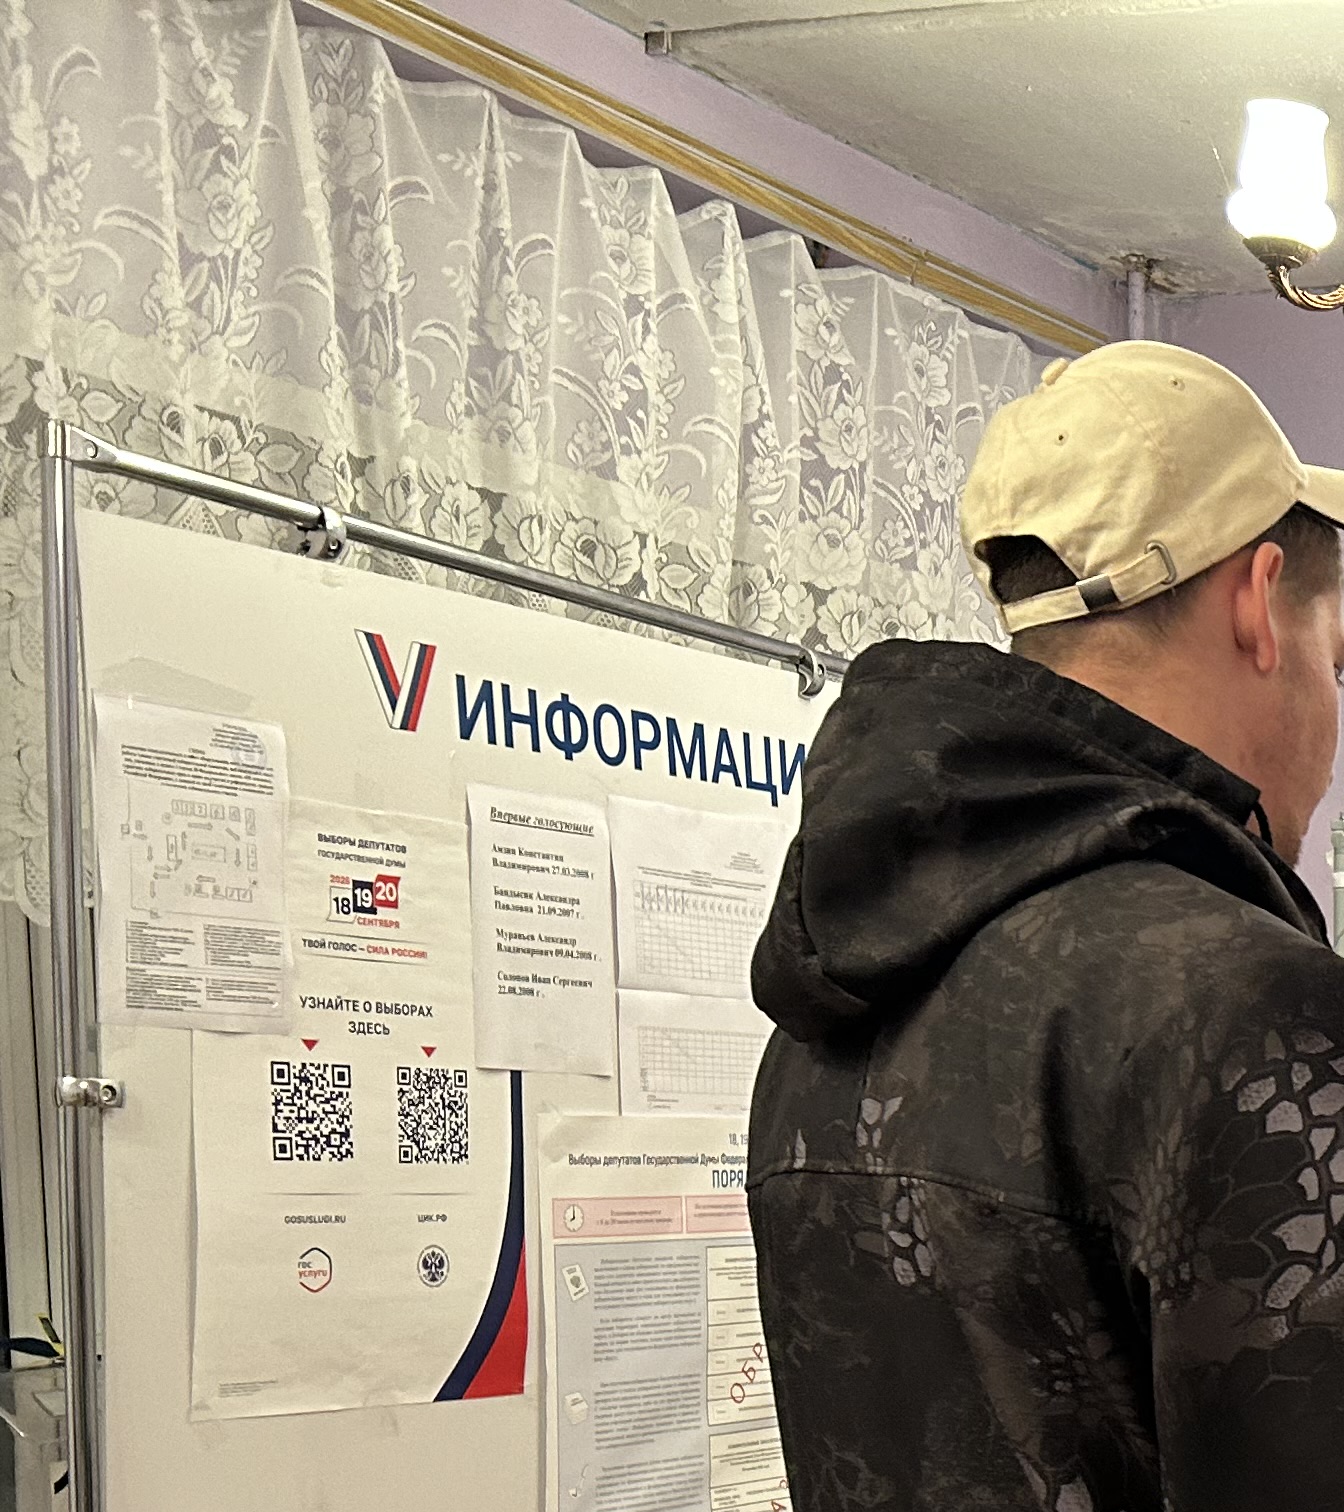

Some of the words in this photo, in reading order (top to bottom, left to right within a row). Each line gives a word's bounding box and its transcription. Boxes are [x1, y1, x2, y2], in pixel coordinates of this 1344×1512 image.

[455, 673, 806, 807] ИНФОРМАЦИ
[490, 806, 532, 826] Впервые
[317, 833, 356, 846] ВЫБОРЫ
[358, 839, 407, 854] ДЕПУТАТОВ
[317, 849, 384, 866] ГОСУДАРСТВЕННОЙ
[385, 859, 406, 868] ДУМЫ
[332, 896, 351, 915] 18
[354, 888, 373, 908] 19
[375, 882, 397, 902] 20
[356, 916, 400, 929] СЕНТЯБРЯ
[301, 938, 326, 950] ТВОЙ
[327, 941, 358, 953] ГОЛОС
[366, 945, 390, 956] СИЛА
[299, 995, 360, 1013] УЗНАЙТЕ
[363, 1000, 372, 1013] О
[375, 1001, 434, 1018] ВЫБОРАХ
[348, 1020, 391, 1036] ЗДЕСЬ
[568, 1153, 601, 1167] Выборы
[603, 1154, 641, 1167] депутатов
[642, 1153, 699, 1167] Государственной
[712, 1169, 744, 1188] ПОРЯ
[284, 1215, 347, 1225] GOSUSLUGI.RU
